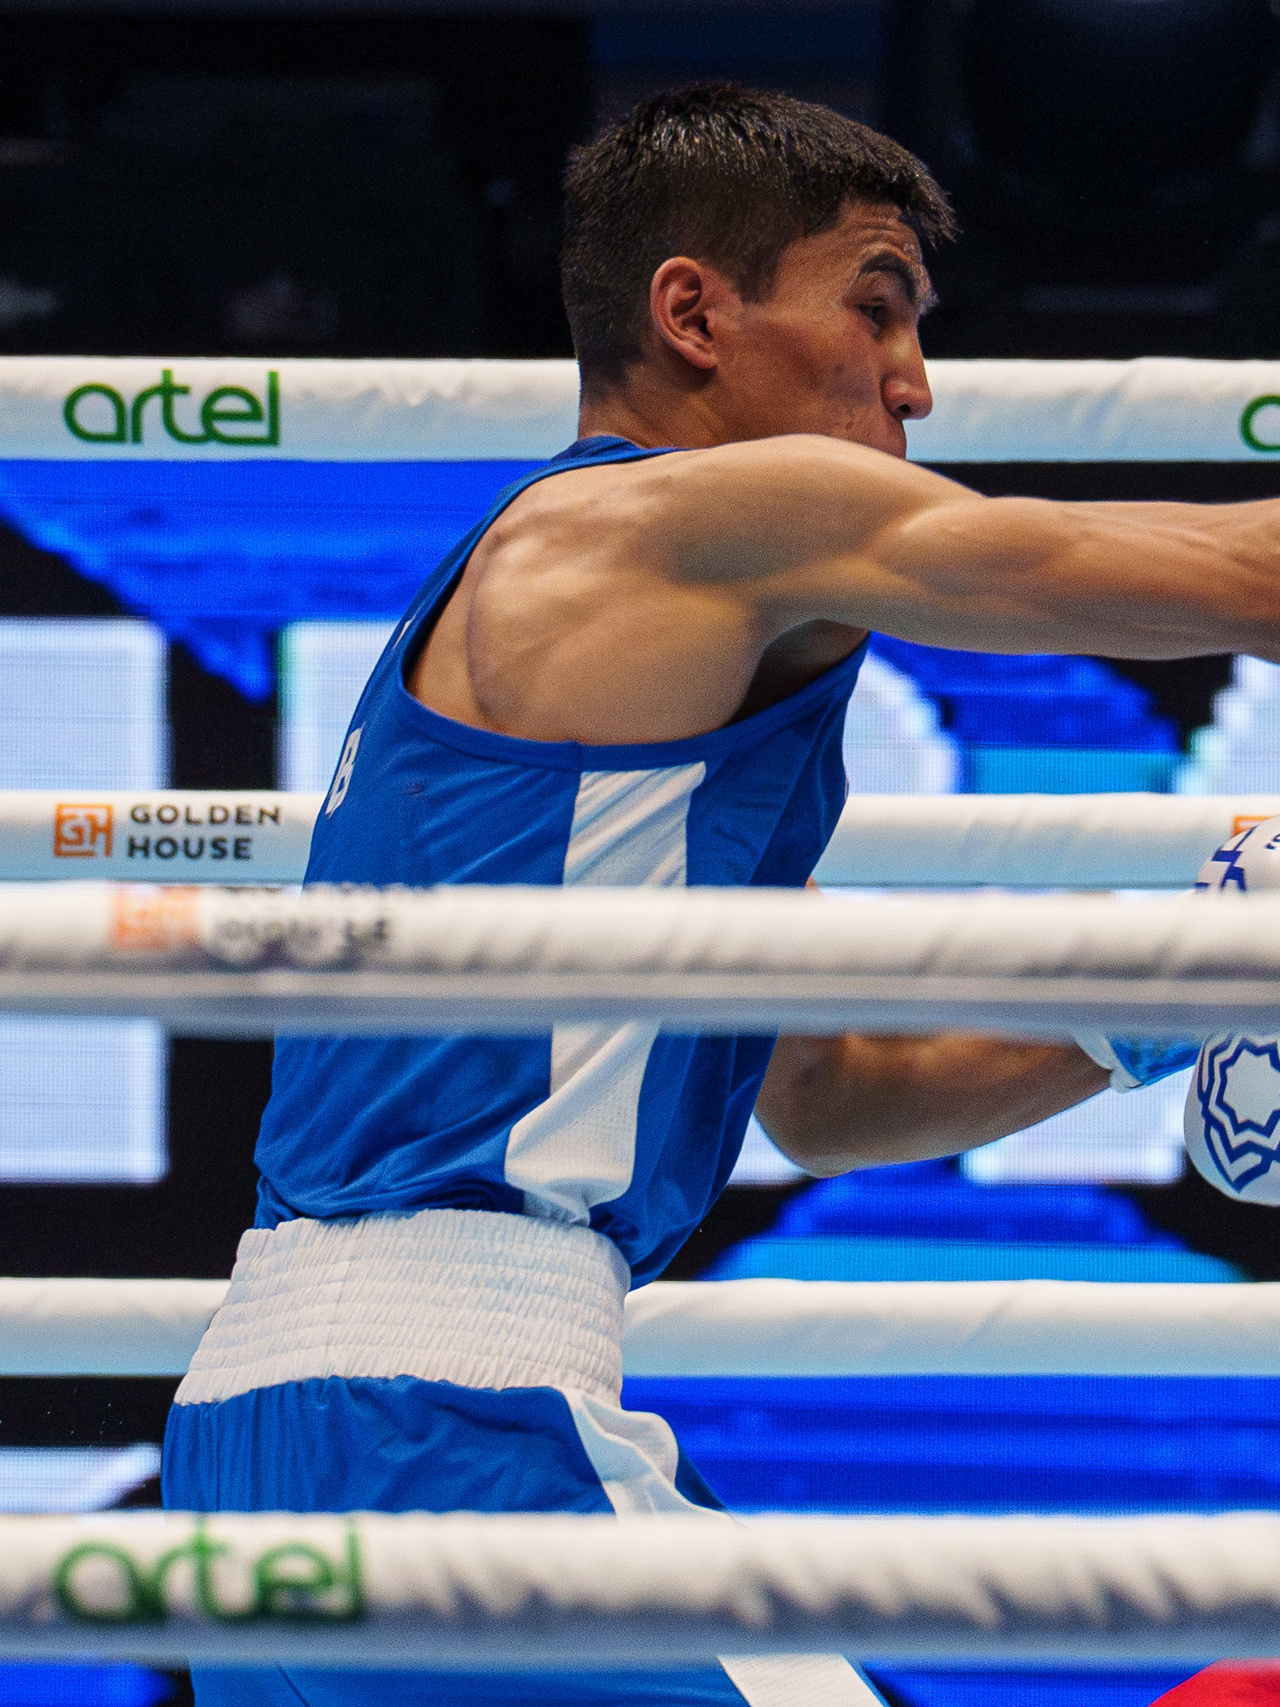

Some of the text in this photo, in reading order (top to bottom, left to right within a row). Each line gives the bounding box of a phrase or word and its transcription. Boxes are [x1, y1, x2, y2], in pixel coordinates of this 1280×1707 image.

[63, 369, 281, 446] artel
[129, 803, 281, 826] GOLDEN
[127, 837, 254, 860] HOUSE
[52, 1515, 363, 1623] artel
